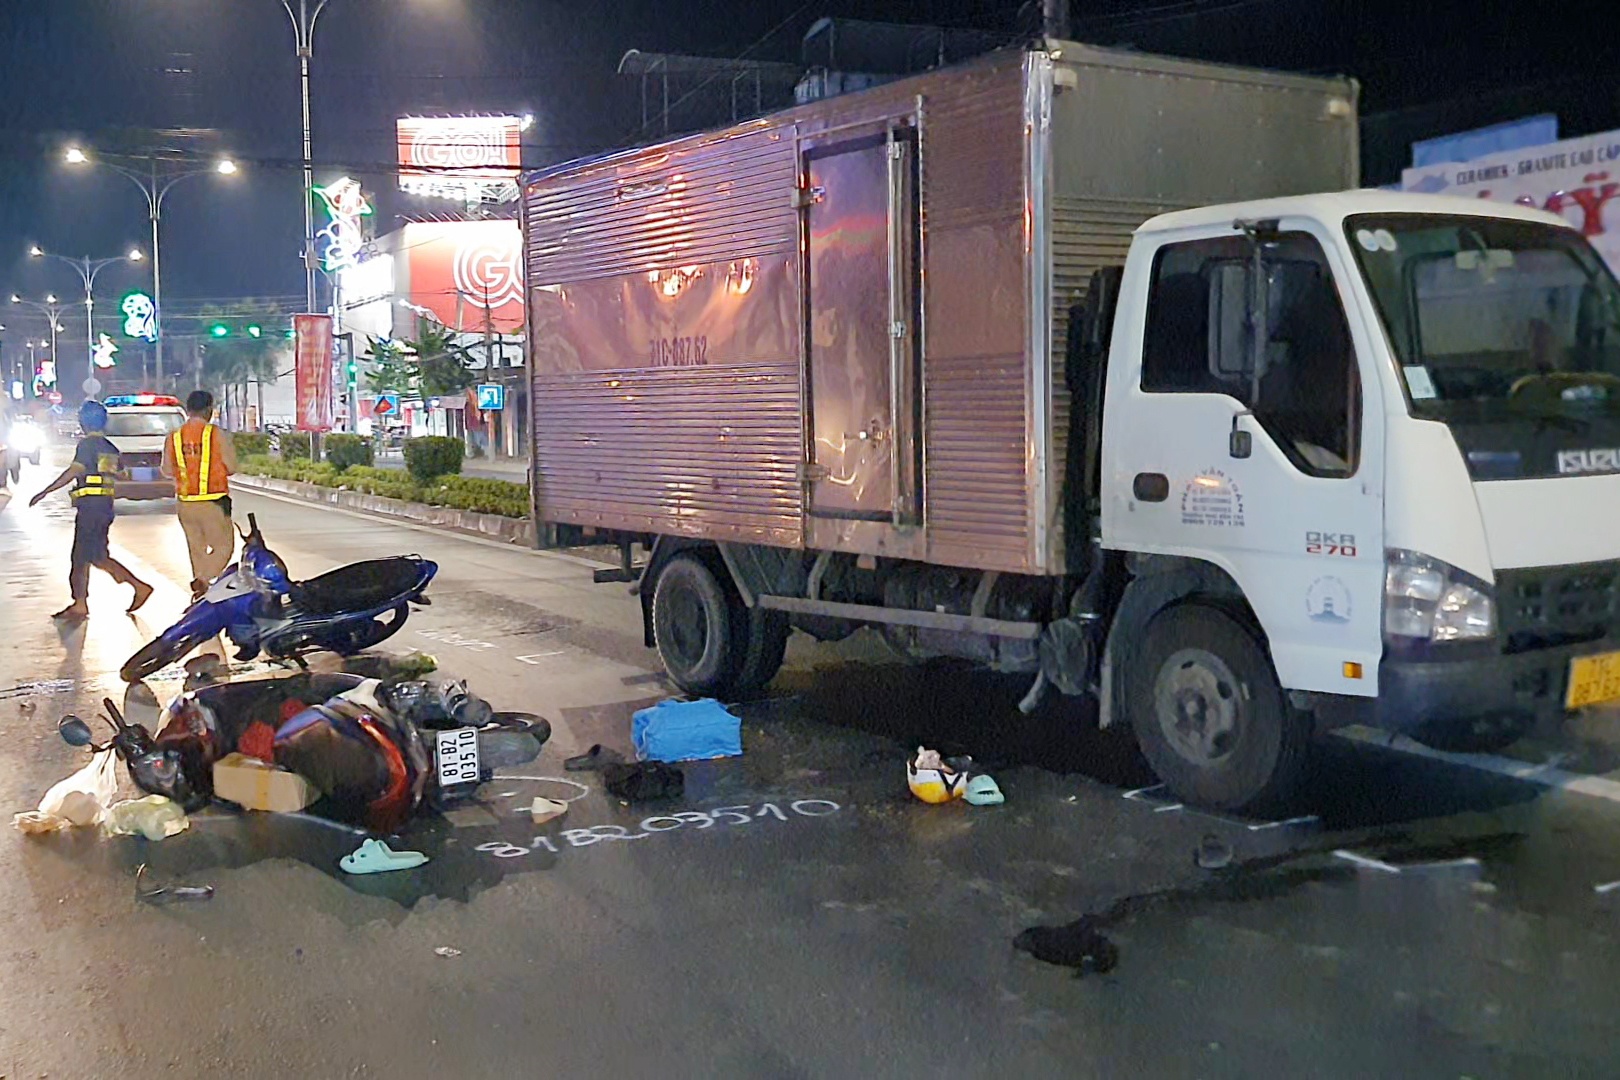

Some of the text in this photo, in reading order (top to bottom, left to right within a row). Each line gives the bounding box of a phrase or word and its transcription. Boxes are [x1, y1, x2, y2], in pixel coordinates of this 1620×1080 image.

[1306, 531, 1355, 545] QKR
[1306, 543, 1356, 556] 270
[459, 731, 476, 779] 035.10
